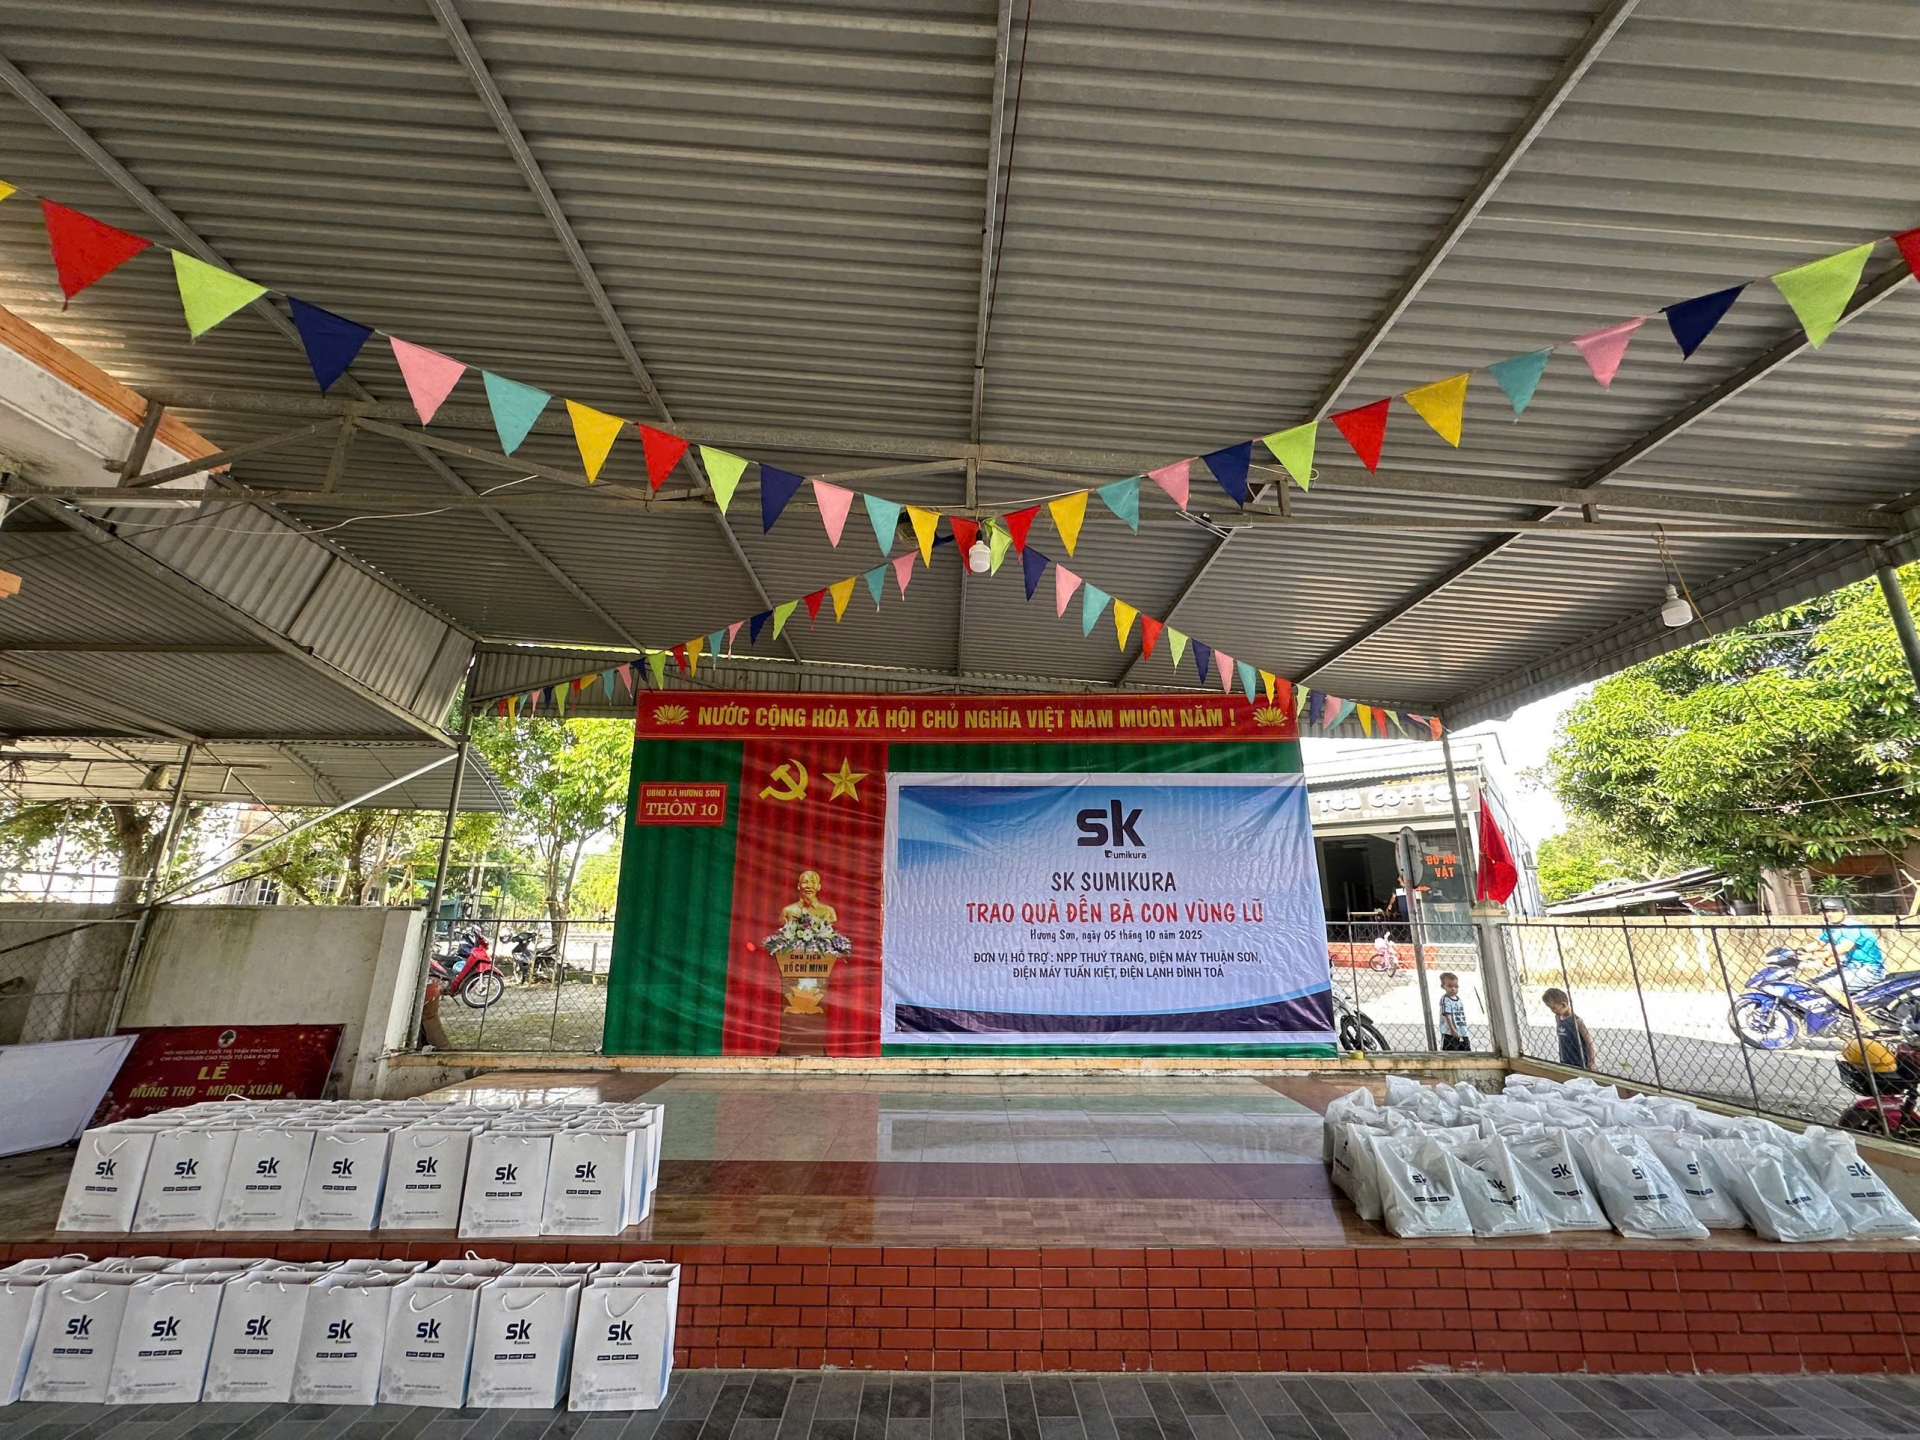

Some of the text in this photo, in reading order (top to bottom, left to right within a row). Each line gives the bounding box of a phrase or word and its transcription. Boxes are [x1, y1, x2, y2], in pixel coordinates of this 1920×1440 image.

[698, 702, 1236, 733] NƯỚC CỘNG HÒA XÃ HỘI CHỦ NGHĨA VIỆT NAM MUÔN NĂM !
[646, 788, 720, 797] UBND XÃ HƯƠNG SƠN
[645, 798, 718, 816] THÔN 10
[1051, 871, 1177, 893] SK SUMIKURA
[966, 894, 1263, 925] TRAO QUÀ ĐẾN BÀ CON VÙNG LŨ
[1030, 928, 1203, 943] Hương Sơn, ngày 05 tháng 10 năm 2025
[973, 951, 996, 963] ĐƠN
[998, 952, 1008, 965] VỊ
[1010, 948, 1025, 963] HỖ
[1056, 952, 1077, 963] NPP
[1080, 950, 1107, 963] THUÝ
[1110, 951, 1147, 964] TRANG,
[1149, 950, 1173, 964] ĐIỆN
[1175, 950, 1197, 963] MÁY
[1200, 950, 1235, 965] THUẬN
[1237, 951, 1262, 964] SƠN,
[795, 961, 807, 973] CHÍ
[808, 963, 828, 973] MINH
[1013, 965, 1037, 980] ĐIỆN
[1040, 965, 1061, 978] MÁY
[1064, 964, 1091, 978] TUẤN
[1093, 965, 1117, 980] KIỆT,
[1120, 965, 1144, 980] ĐIỆN
[1146, 967, 1174, 980] LẠNH
[1176, 965, 1201, 978] ĐÌNH
[197, 1061, 231, 1080] LỄ
[171, 1086, 196, 1099] THỌ
[248, 1082, 283, 1096] XUÂN
